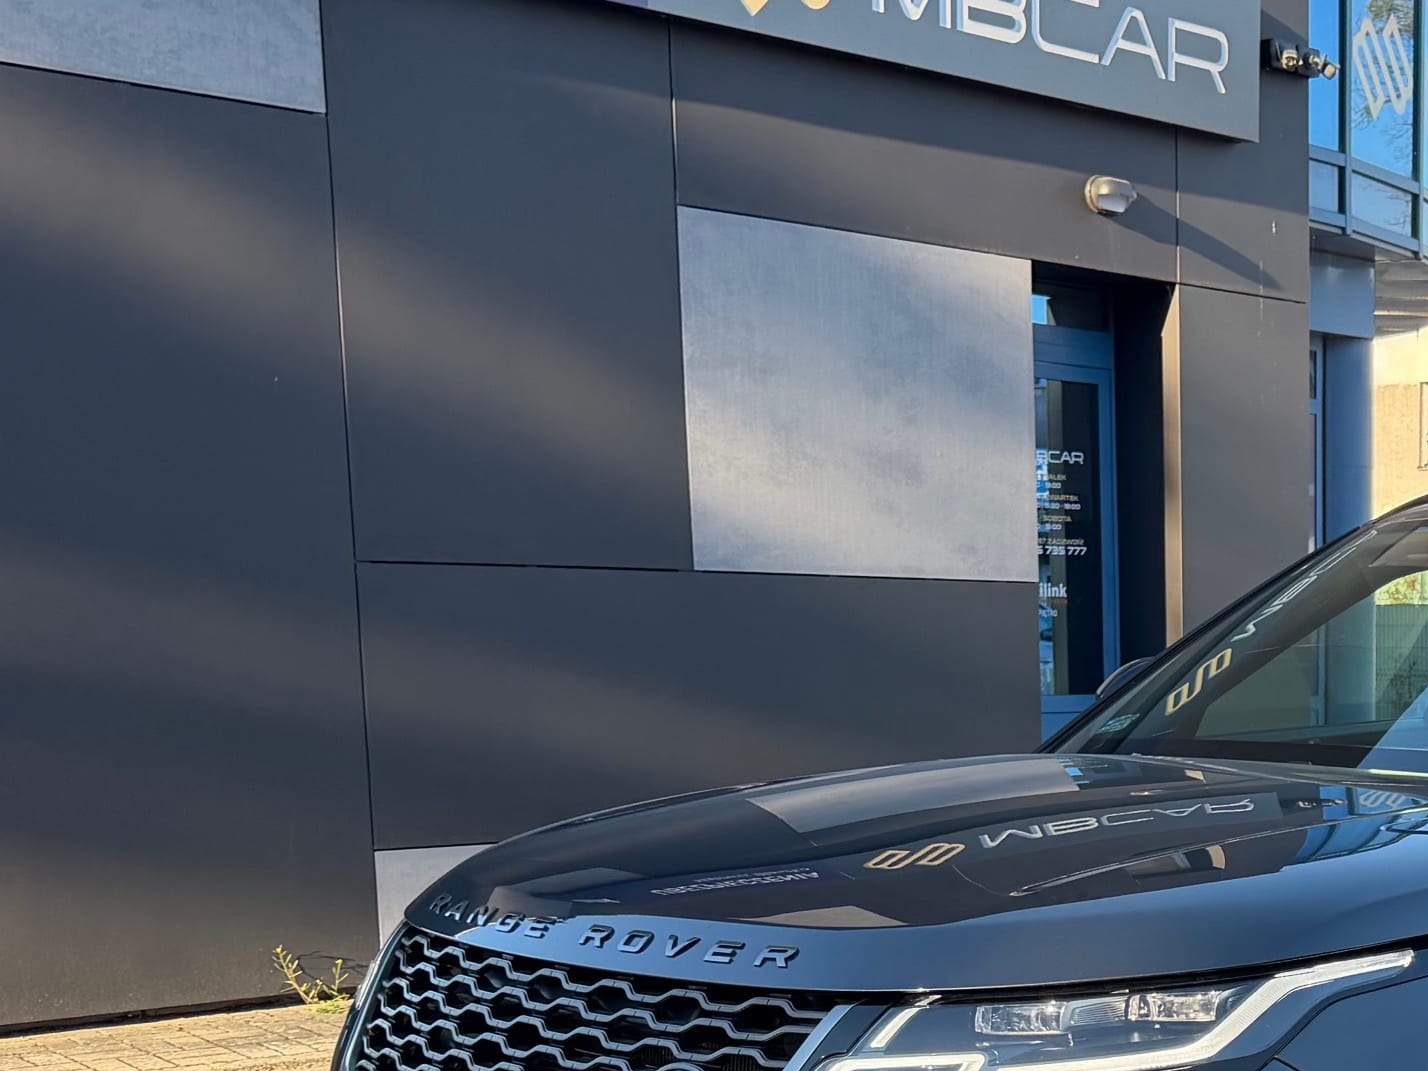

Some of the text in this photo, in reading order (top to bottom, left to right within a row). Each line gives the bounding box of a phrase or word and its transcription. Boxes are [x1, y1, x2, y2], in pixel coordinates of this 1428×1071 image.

[1036, 450, 1084, 464] BCAR
[1067, 546, 1088, 556] 777
[1039, 582, 1068, 598] ilink
[429, 894, 799, 969] RANGE ROVER
